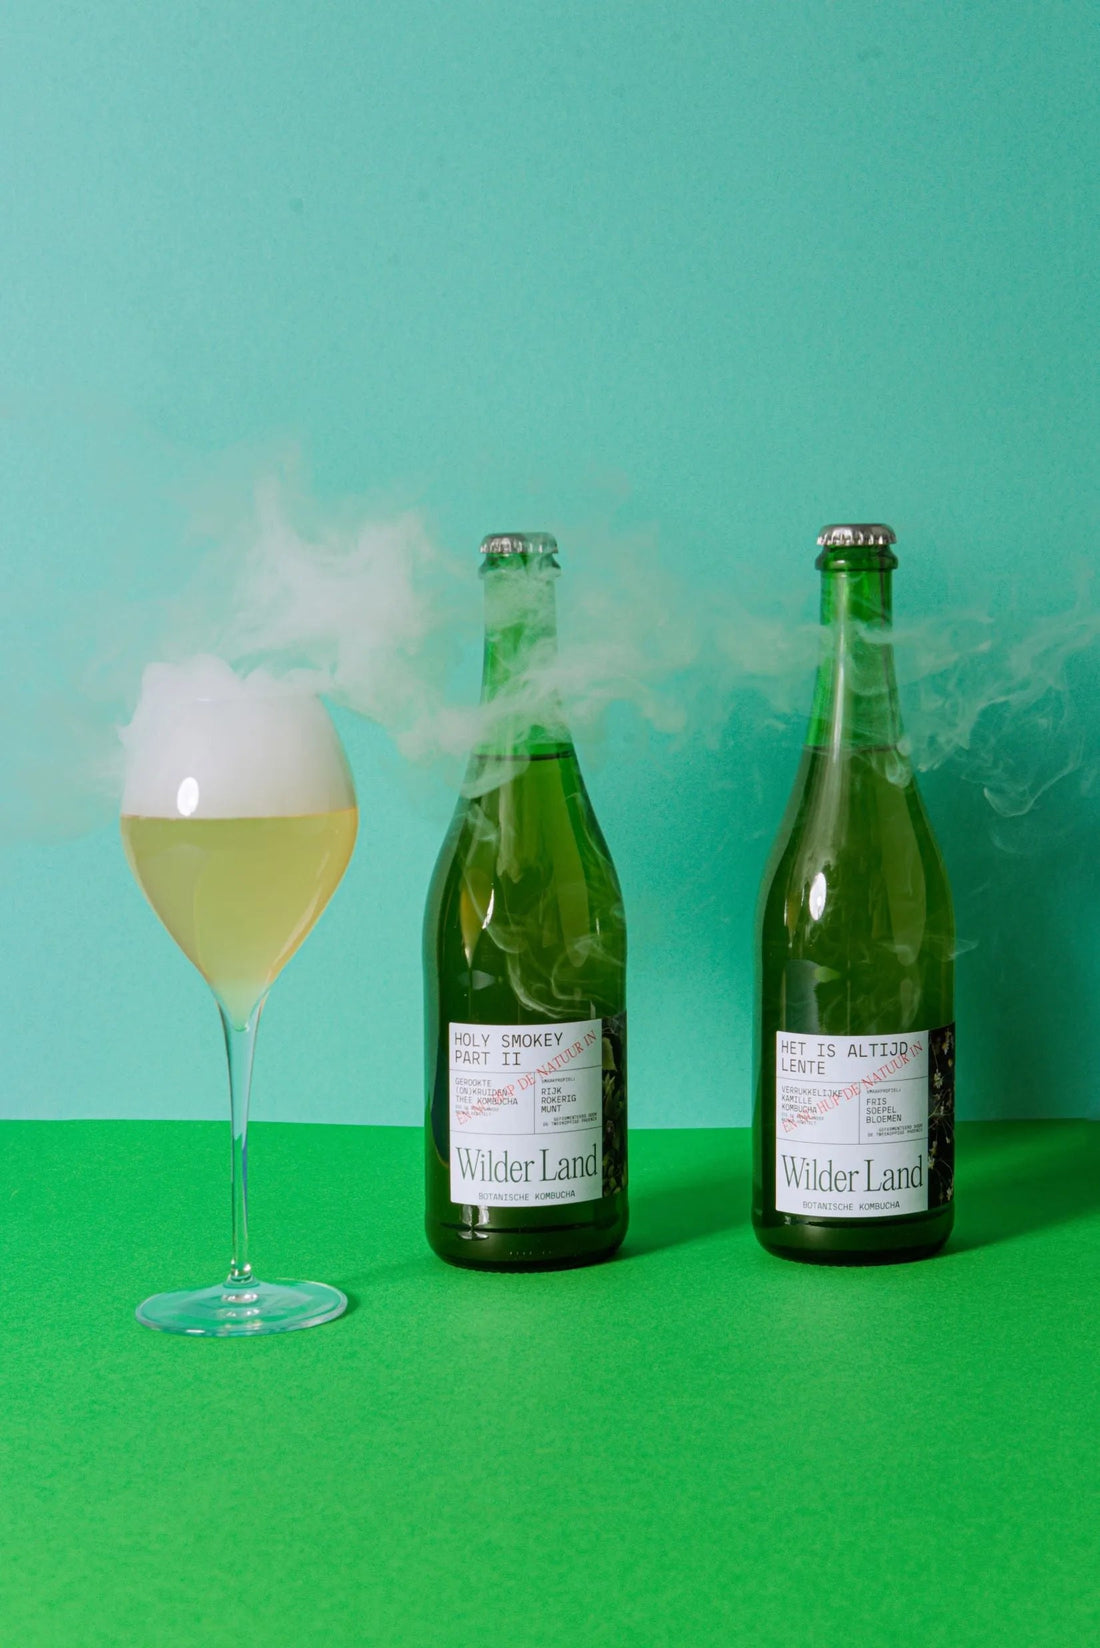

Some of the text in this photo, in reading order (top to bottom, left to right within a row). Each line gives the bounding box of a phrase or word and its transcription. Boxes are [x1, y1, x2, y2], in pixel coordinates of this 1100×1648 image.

[454, 1031, 563, 1048] HOLY SMOKEY
[781, 1040, 908, 1058] HET IS ALTIJD
[455, 1049, 521, 1066] PART II
[517, 1074, 536, 1091] DE
[536, 1041, 584, 1078] NATUUR
[583, 1029, 597, 1046] IN
[781, 1057, 826, 1075] LENTE
[455, 1077, 492, 1087] GEROOKTE
[816, 1092, 841, 1114] HUP
[842, 1082, 861, 1101] DE
[861, 1053, 910, 1088] NATUUR
[909, 1040, 923, 1057] IN
[541, 1087, 562, 1096] RIJK
[781, 1086, 843, 1097] VERRUKKELIJKE
[456, 1095, 518, 1105] THEE KOMBUCHA
[541, 1095, 577, 1104] ROKERIG
[781, 1095, 812, 1105] KAMILLE
[866, 1098, 887, 1106] FRIS
[541, 1105, 562, 1113] MUNT
[781, 1103, 817, 1113] KOMBUCHA
[866, 1106, 897, 1115] SOEPEL
[866, 1114, 902, 1124] BLOEMEN
[456, 1143, 598, 1183] Wilder Land
[781, 1154, 924, 1193] Wilder Land
[478, 1190, 576, 1201] BOTANISCHE KOMBUCHA
[802, 1200, 901, 1211] BOTANISCHE KOMBUCHA
